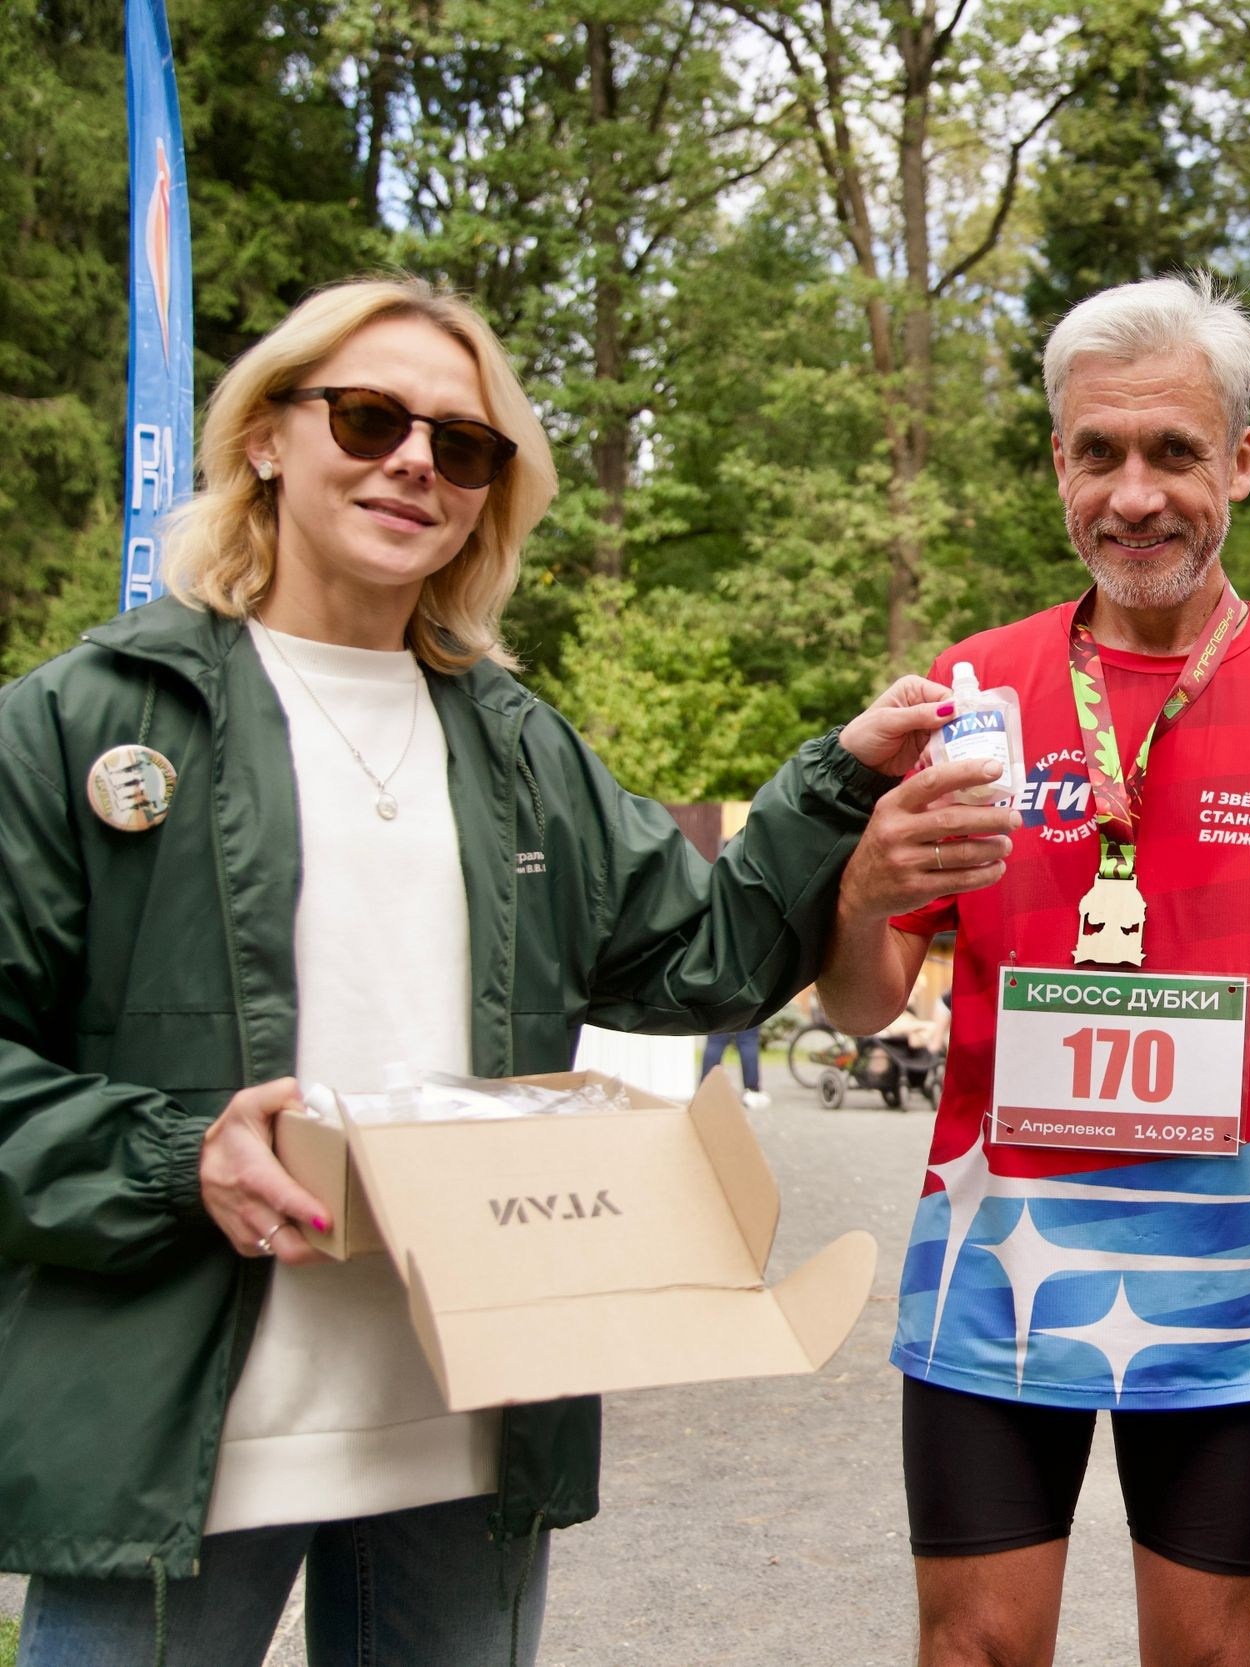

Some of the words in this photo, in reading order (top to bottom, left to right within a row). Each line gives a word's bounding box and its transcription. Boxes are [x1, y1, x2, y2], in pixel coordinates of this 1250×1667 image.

[1193, 607, 1236, 683] АПРЕЛЕВКА
[1200, 791, 1215, 803] И
[1027, 983, 1122, 1007] КРОСС
[1127, 988, 1219, 1011] ДУБКИ
[1062, 1027, 1176, 1104] 170
[1019, 1119, 1116, 1137] Апрелевка
[1134, 1124, 1215, 1142] 14.09.25
